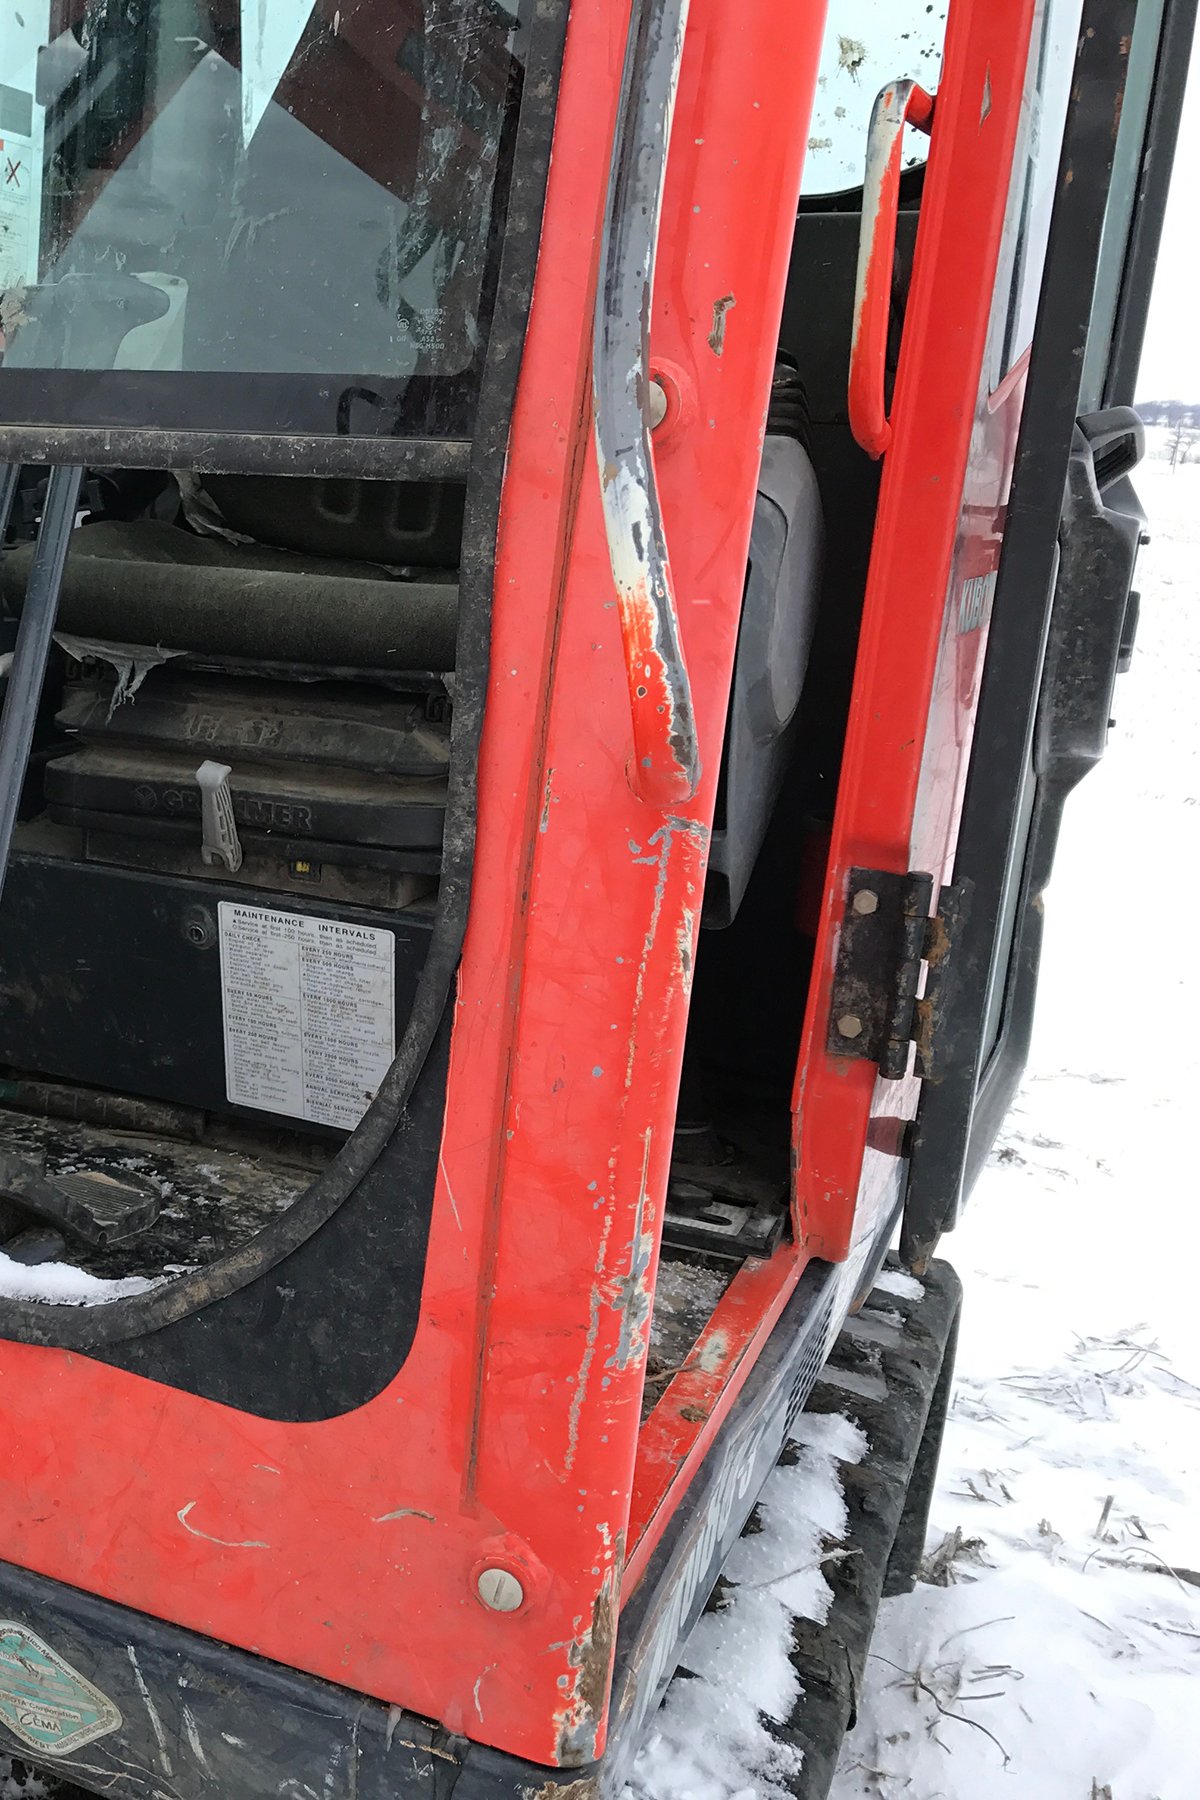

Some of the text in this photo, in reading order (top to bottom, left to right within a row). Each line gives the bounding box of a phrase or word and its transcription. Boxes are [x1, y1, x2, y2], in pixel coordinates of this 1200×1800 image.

[234, 909, 375, 940] MAINTENANCE INTERVALS
[305, 1083, 327, 1093] ANNUAL
[330, 1089, 360, 1100] SERVICING
[306, 1098, 331, 1108] BIENNIAL
[334, 1105, 363, 1116] SERVICING
[20, 1712, 62, 1733] CEMA
